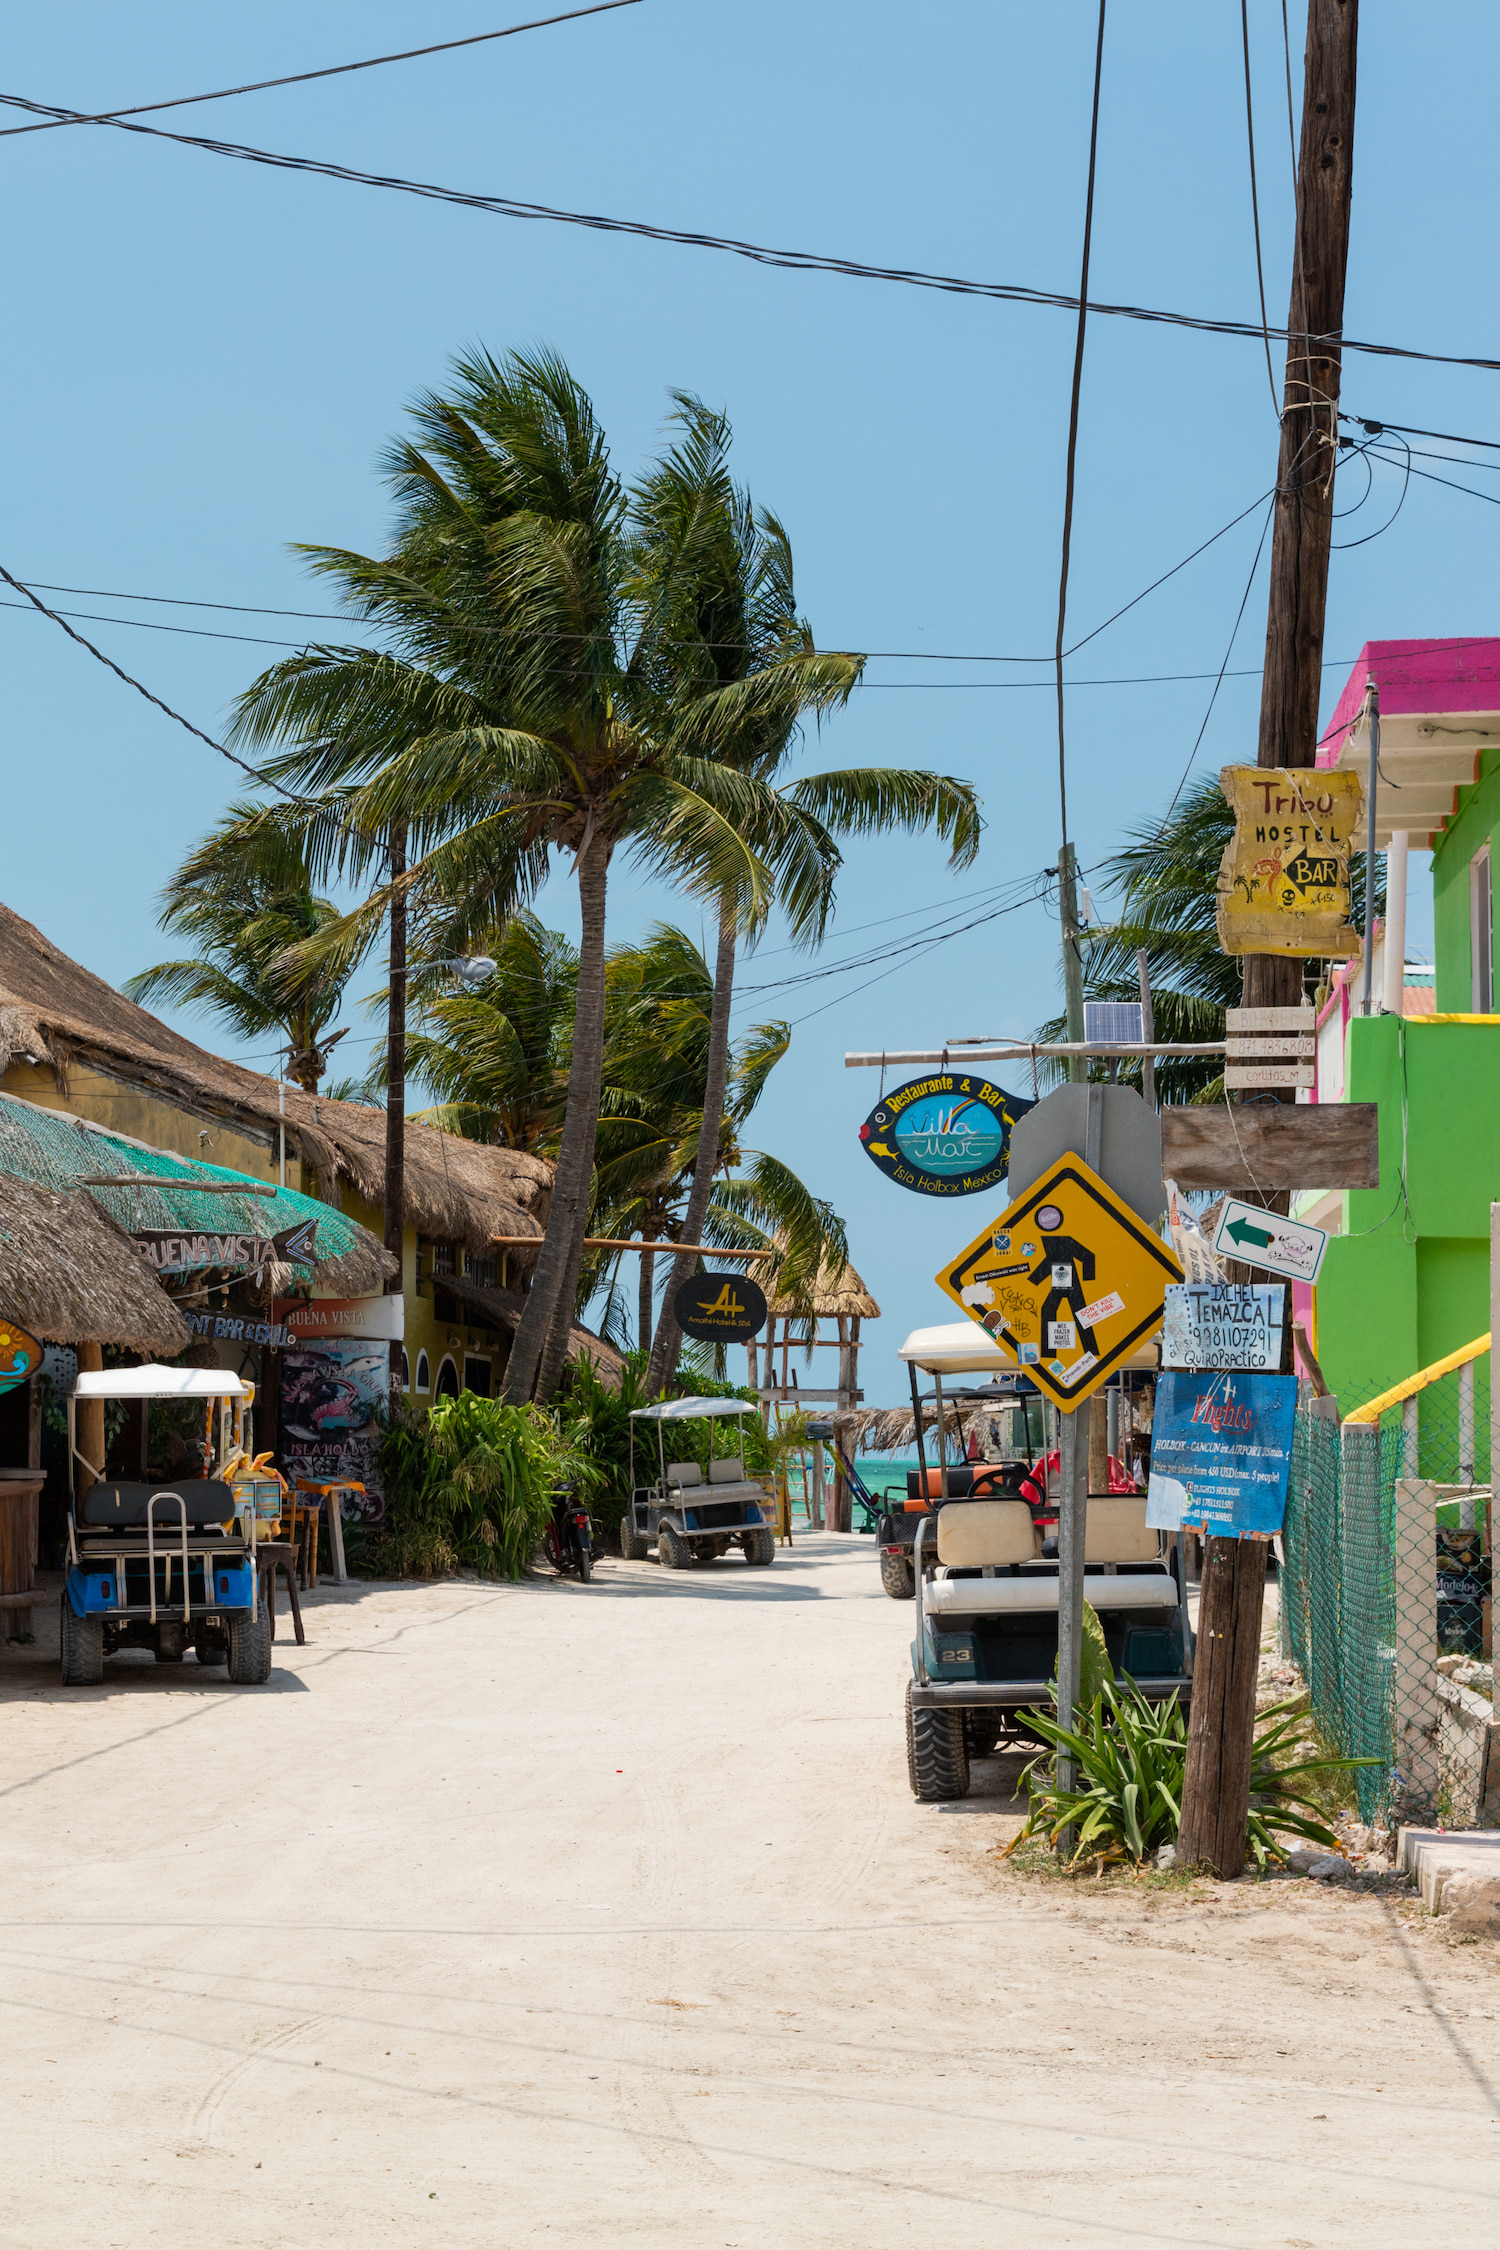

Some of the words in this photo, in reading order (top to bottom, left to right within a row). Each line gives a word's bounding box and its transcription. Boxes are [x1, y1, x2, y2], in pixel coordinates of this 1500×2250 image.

[1252, 781, 1333, 814] Tribu
[1256, 825, 1341, 843] HOSTEL
[1295, 860, 1336, 884] BAR
[885, 1075, 954, 1113] Restaurante
[960, 1078, 971, 1092] &
[977, 1082, 1006, 1108] Bar
[911, 1106, 977, 1136] Villa
[914, 1137, 982, 1158] Mar
[893, 1164, 915, 1184] Isla
[917, 1175, 960, 1193] Holbox
[136, 1236, 211, 1269] BUENA
[213, 1235, 279, 1264] VISTA
[1211, 1284, 1262, 1302] IXCHEL
[1080, 1303, 1099, 1317] DON'T
[1100, 1296, 1115, 1308] KILL
[1087, 1310, 1100, 1320] THE
[1188, 1291, 1283, 1329] TEMAZCAL
[213, 1317, 245, 1341] BAR
[245, 1323, 255, 1339] &
[287, 1311, 328, 1326] BUENA
[331, 1311, 366, 1326] VISTA
[713, 1318, 731, 1327] Hotel
[738, 1319, 752, 1328] SPA
[1190, 1394, 1253, 1433] Flights
[291, 1443, 321, 1457] ISLA
[1190, 1441, 1221, 1453] CANCUN
[1194, 1464, 1207, 1475] from
[1220, 1466, 1235, 1478] USD
[1216, 1486, 1241, 1497] HOLBOX
[942, 1649, 970, 1662] 23
